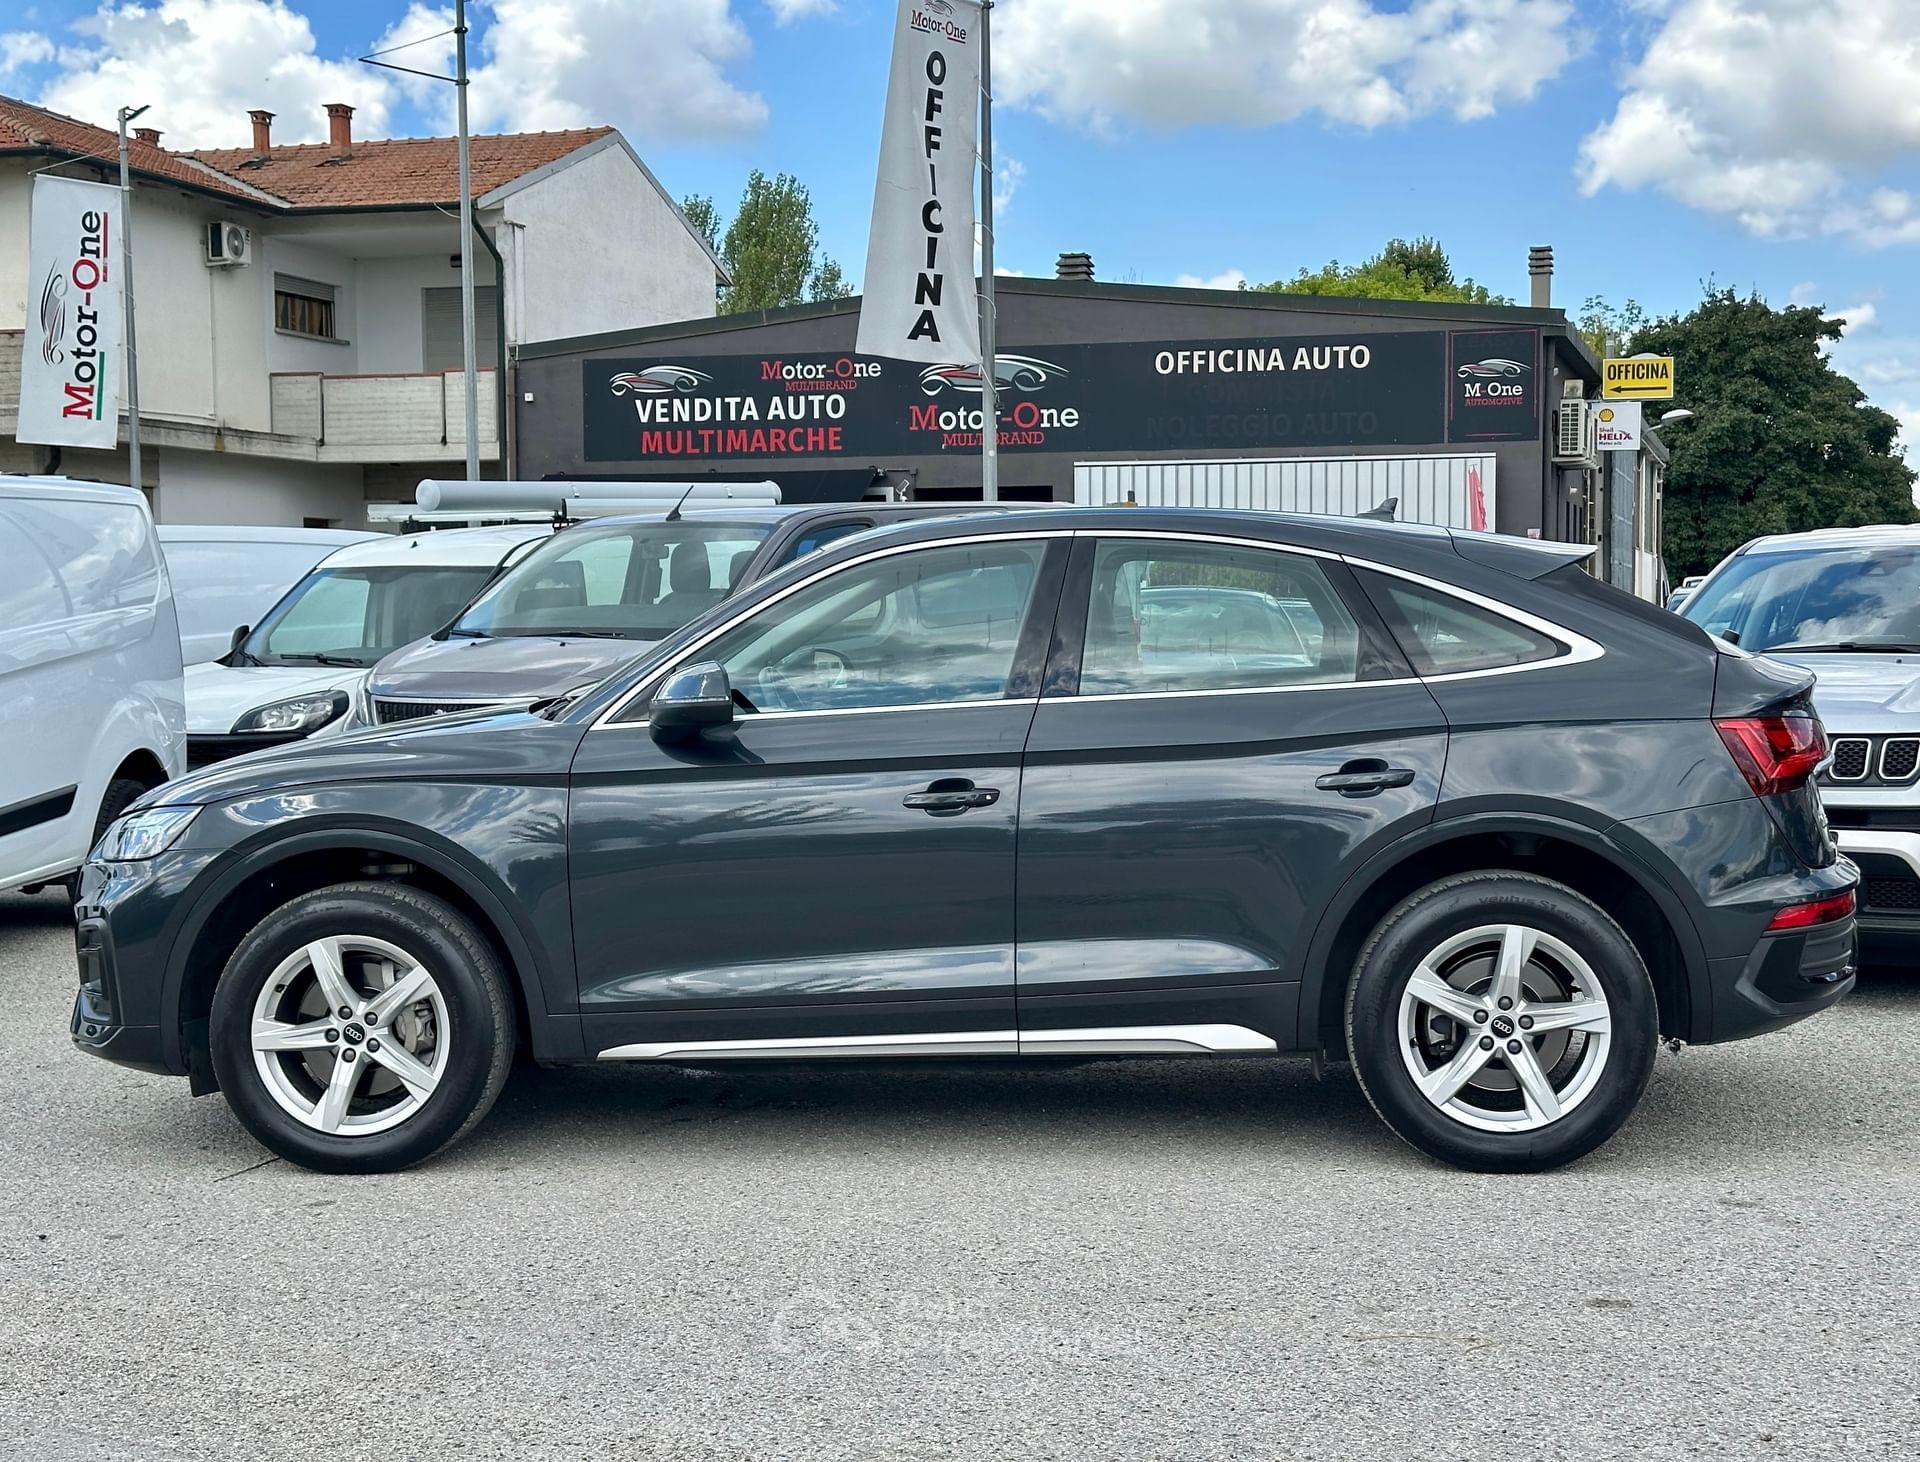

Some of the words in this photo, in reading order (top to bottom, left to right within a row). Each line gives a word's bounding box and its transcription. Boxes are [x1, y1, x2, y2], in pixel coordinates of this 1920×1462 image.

[911, 10, 966, 40] Motor-One
[907, 51, 947, 343] OFFICINA
[62, 210, 101, 420] Motor-One
[760, 358, 882, 380] Motor-One
[1154, 348, 1286, 375] OFFICINA
[1292, 345, 1371, 371] AUTO
[1607, 362, 1669, 381] OFFICINA
[785, 379, 858, 392] MULTIBRAND
[635, 396, 760, 423] VENDITA
[767, 393, 847, 421] AUTO
[909, 401, 1079, 431] Moto-One
[1465, 397, 1523, 407] AUTOMOTIVE
[641, 426, 843, 455] MULTIMARCHE
[1599, 431, 1633, 440] HELIX
